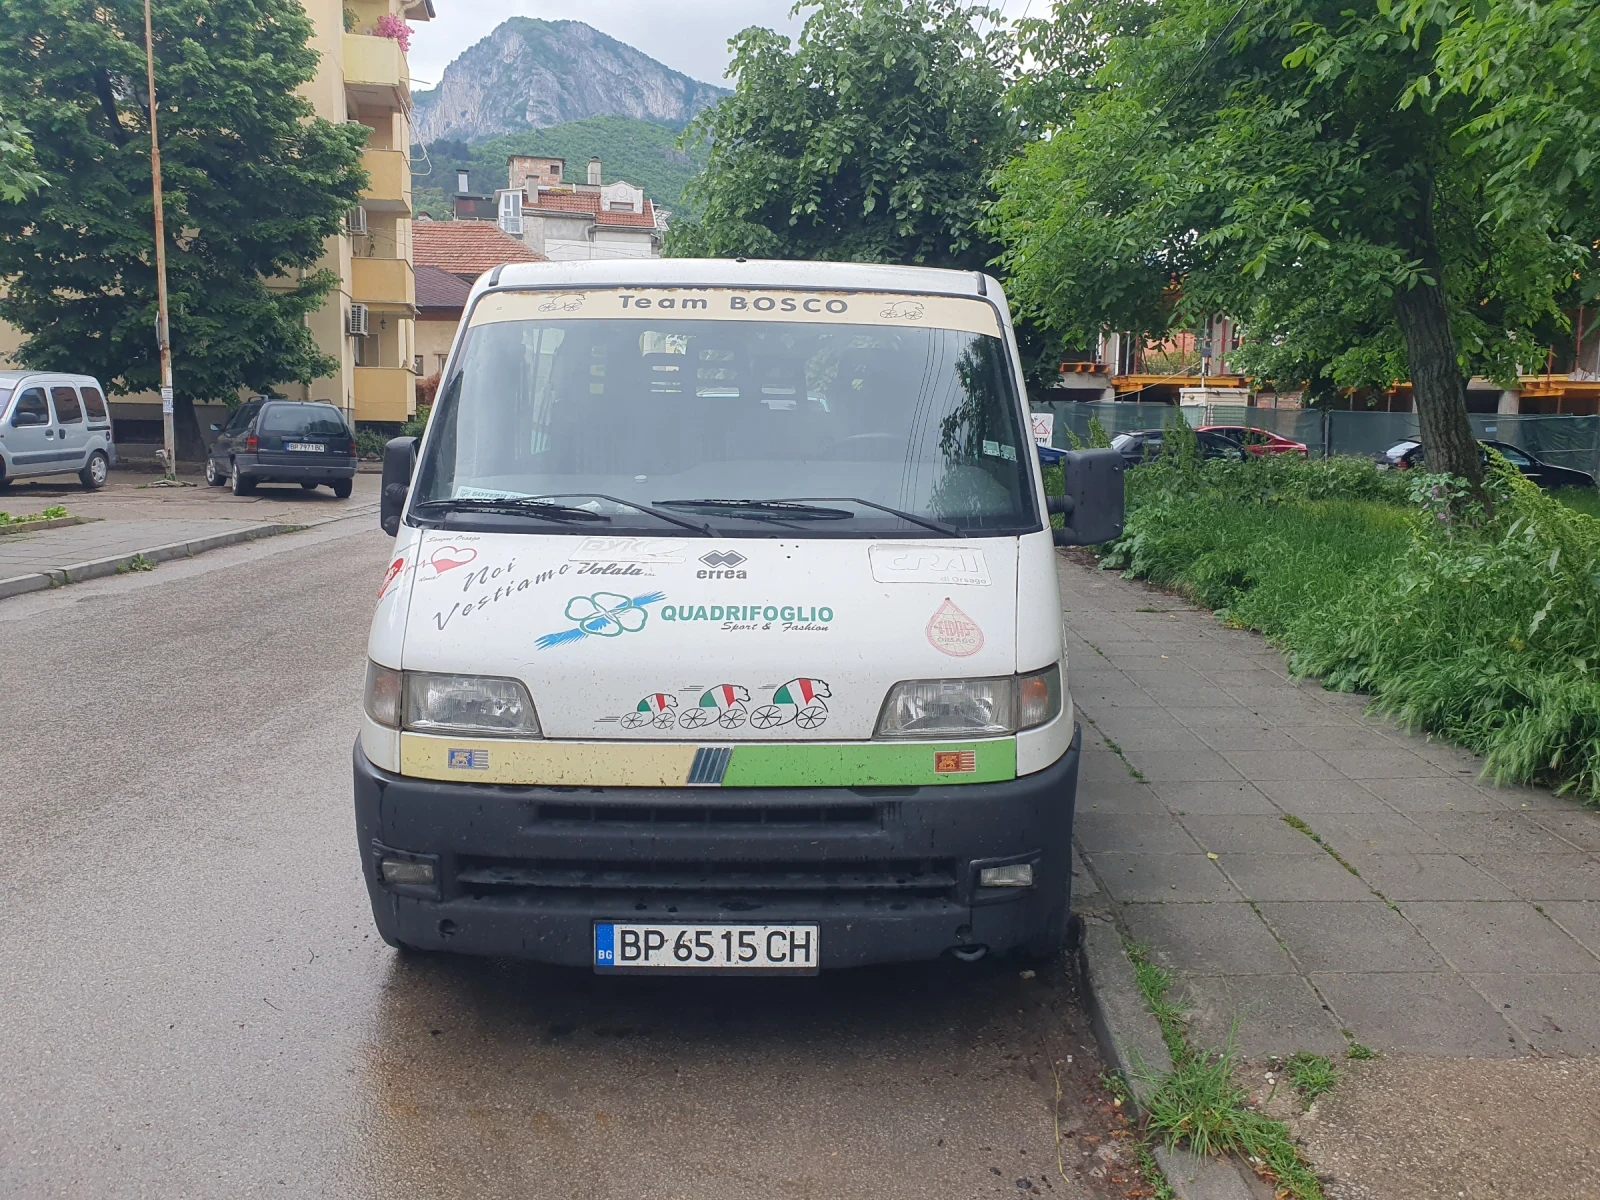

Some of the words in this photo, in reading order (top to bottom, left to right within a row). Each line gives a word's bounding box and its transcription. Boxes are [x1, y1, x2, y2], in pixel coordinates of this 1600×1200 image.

[618, 295, 708, 309] Team
[730, 296, 848, 314] BOSCO
[464, 557, 517, 592] Noi
[952, 576, 987, 585] Orsago
[432, 563, 573, 631] Vestiamo
[660, 605, 834, 623] QUADRIFOGLIO
[720, 622, 759, 633] Sport
[761, 622, 772, 631] &
[781, 622, 829, 632] Fashion
[937, 636, 976, 644] ORSAGO
[620, 929, 665, 961] BP
[673, 930, 758, 962] 6515
[766, 930, 811, 962] CH
[598, 950, 613, 960] BG
